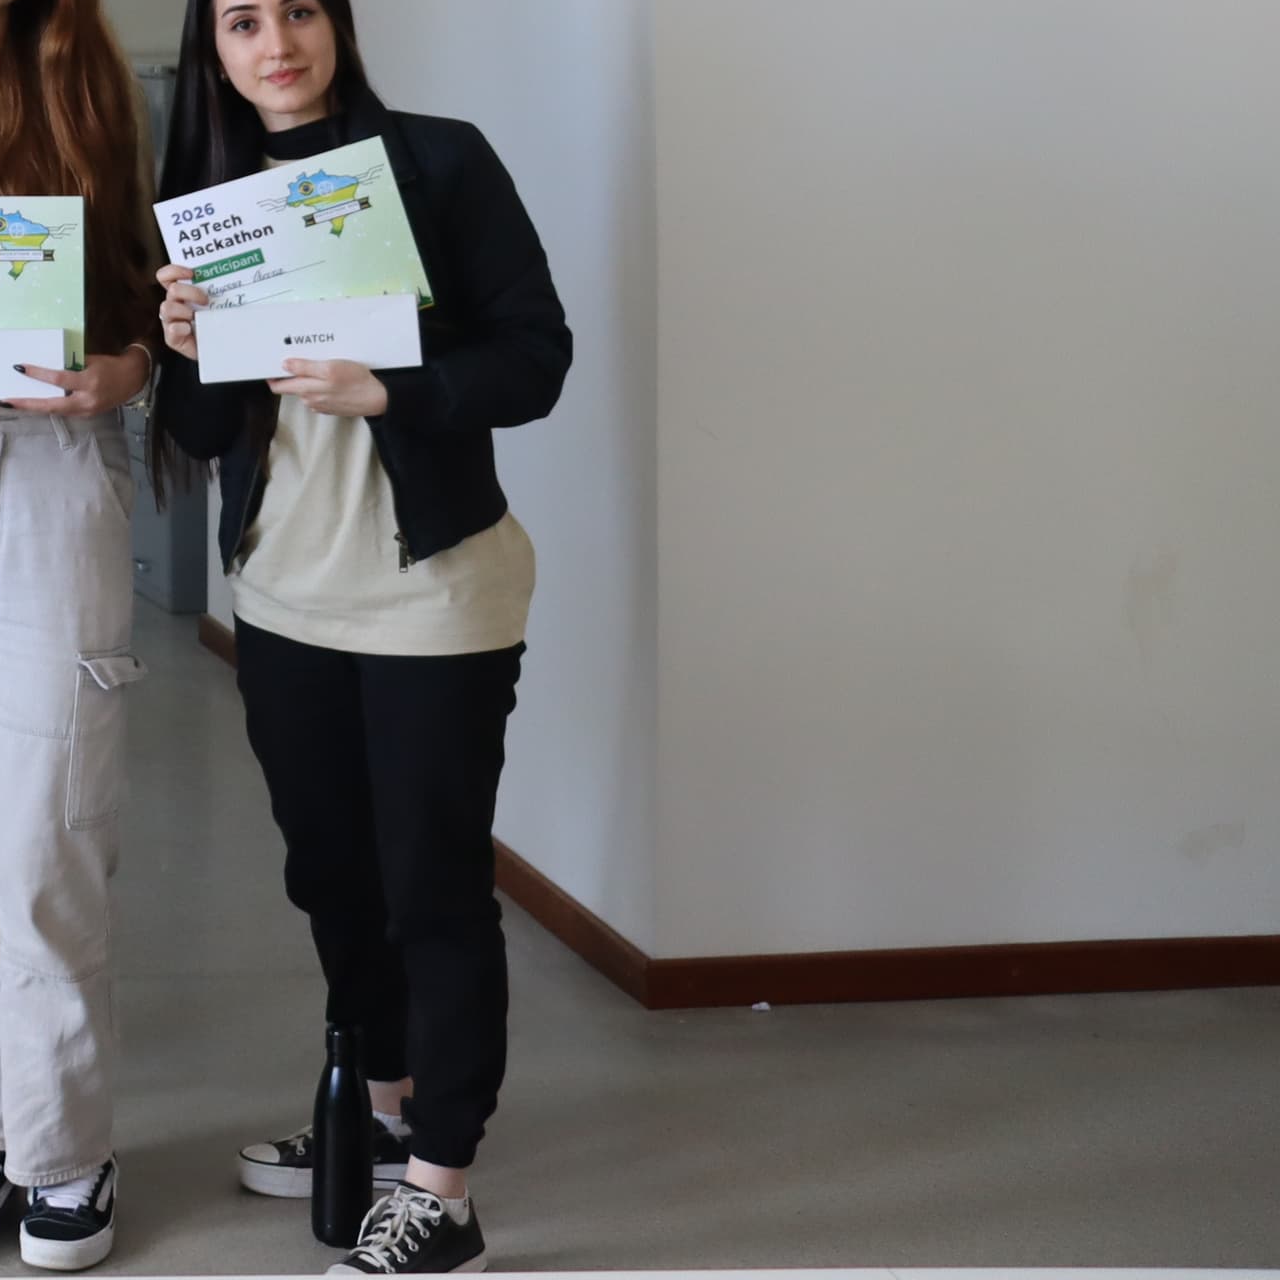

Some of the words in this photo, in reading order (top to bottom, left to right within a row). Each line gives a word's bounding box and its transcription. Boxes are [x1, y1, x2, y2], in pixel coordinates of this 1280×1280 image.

[171, 203, 215, 226] 2026
[177, 213, 243, 243] AgTech
[182, 223, 275, 260] Hackathon
[194, 253, 260, 280] Participant
[294, 333, 335, 344] WATCH
